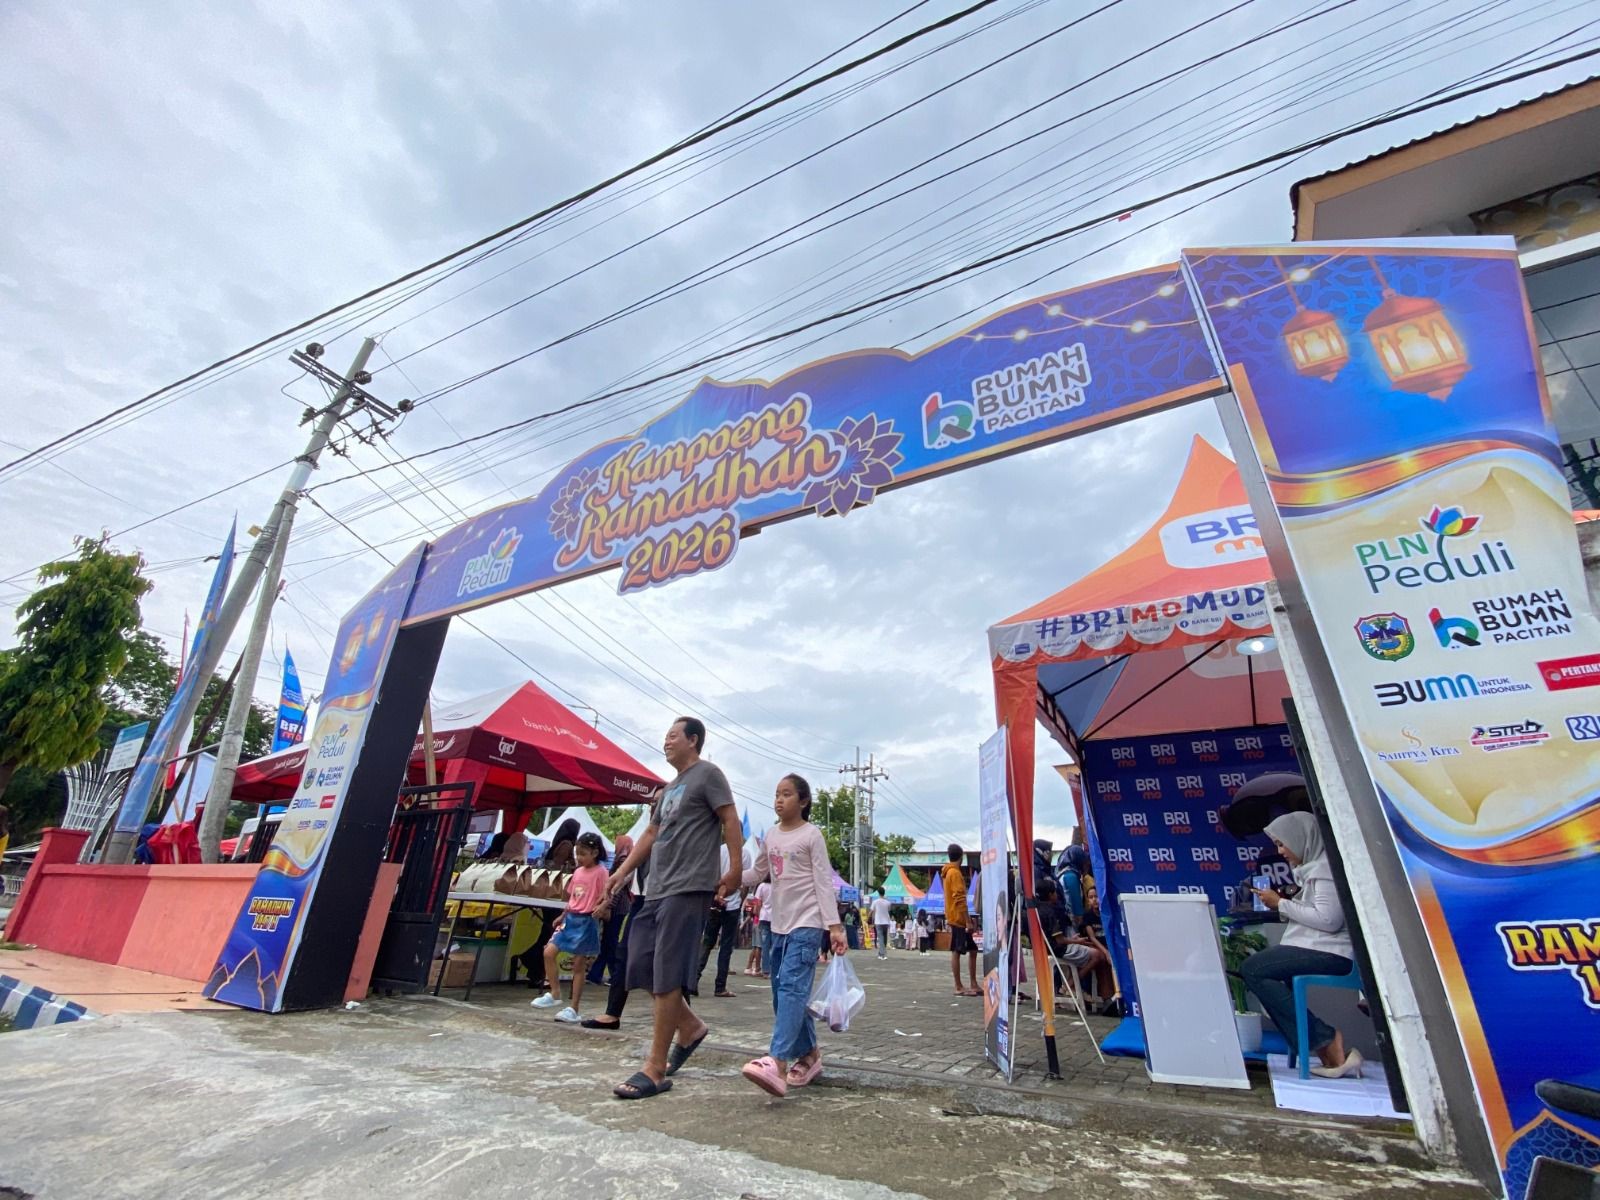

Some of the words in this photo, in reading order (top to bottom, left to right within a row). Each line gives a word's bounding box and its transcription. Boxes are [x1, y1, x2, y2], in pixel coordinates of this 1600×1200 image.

[975, 346, 1083, 396] RUMAH
[978, 363, 1088, 417] BUMN
[987, 391, 1081, 430] PACITAN
[602, 393, 809, 499] Kampoeng
[556, 433, 842, 568] Ramadhan
[619, 515, 737, 593] 2026
[1356, 533, 1430, 566] PLN
[467, 556, 491, 574] PLN
[1364, 538, 1516, 594] Peduli
[459, 553, 513, 596] Peduli
[1472, 588, 1565, 616] RUMAH
[1479, 603, 1573, 631] BUMN
[1493, 623, 1572, 644] PACITAN
[1478, 677, 1510, 688] UNTUK
[1481, 684, 1532, 695] INDONESIA
[280, 719, 303, 734] BRI
[317, 738, 347, 759] Peduli
[1151, 744, 1175, 757] BRI
[1191, 740, 1218, 754] BRI
[1234, 737, 1262, 751] BRI
[1112, 747, 1135, 760] BRI
[1199, 753, 1219, 762] mo
[1243, 750, 1265, 759] mo
[1117, 759, 1136, 768] mo
[1158, 757, 1176, 765] mo
[613, 776, 631, 789] bank
[630, 781, 649, 794] jatim
[1096, 780, 1121, 793] BRI
[1135, 778, 1161, 791] BRI
[1176, 775, 1203, 789] BRI
[1219, 772, 1247, 787] BRI
[1103, 793, 1122, 801] mo
[1142, 791, 1161, 799] mo
[1184, 788, 1204, 798] mo
[1122, 813, 1147, 826] BRI
[1163, 811, 1190, 825] BRI
[1130, 827, 1149, 835] mo
[1171, 825, 1192, 834] mo
[1108, 849, 1132, 862] BRI
[1148, 848, 1175, 862] BRI
[1191, 847, 1219, 861] BRI
[1236, 846, 1263, 861] BR
[1114, 862, 1134, 872] mo
[1156, 862, 1176, 871] mo
[1200, 862, 1221, 872] mo
